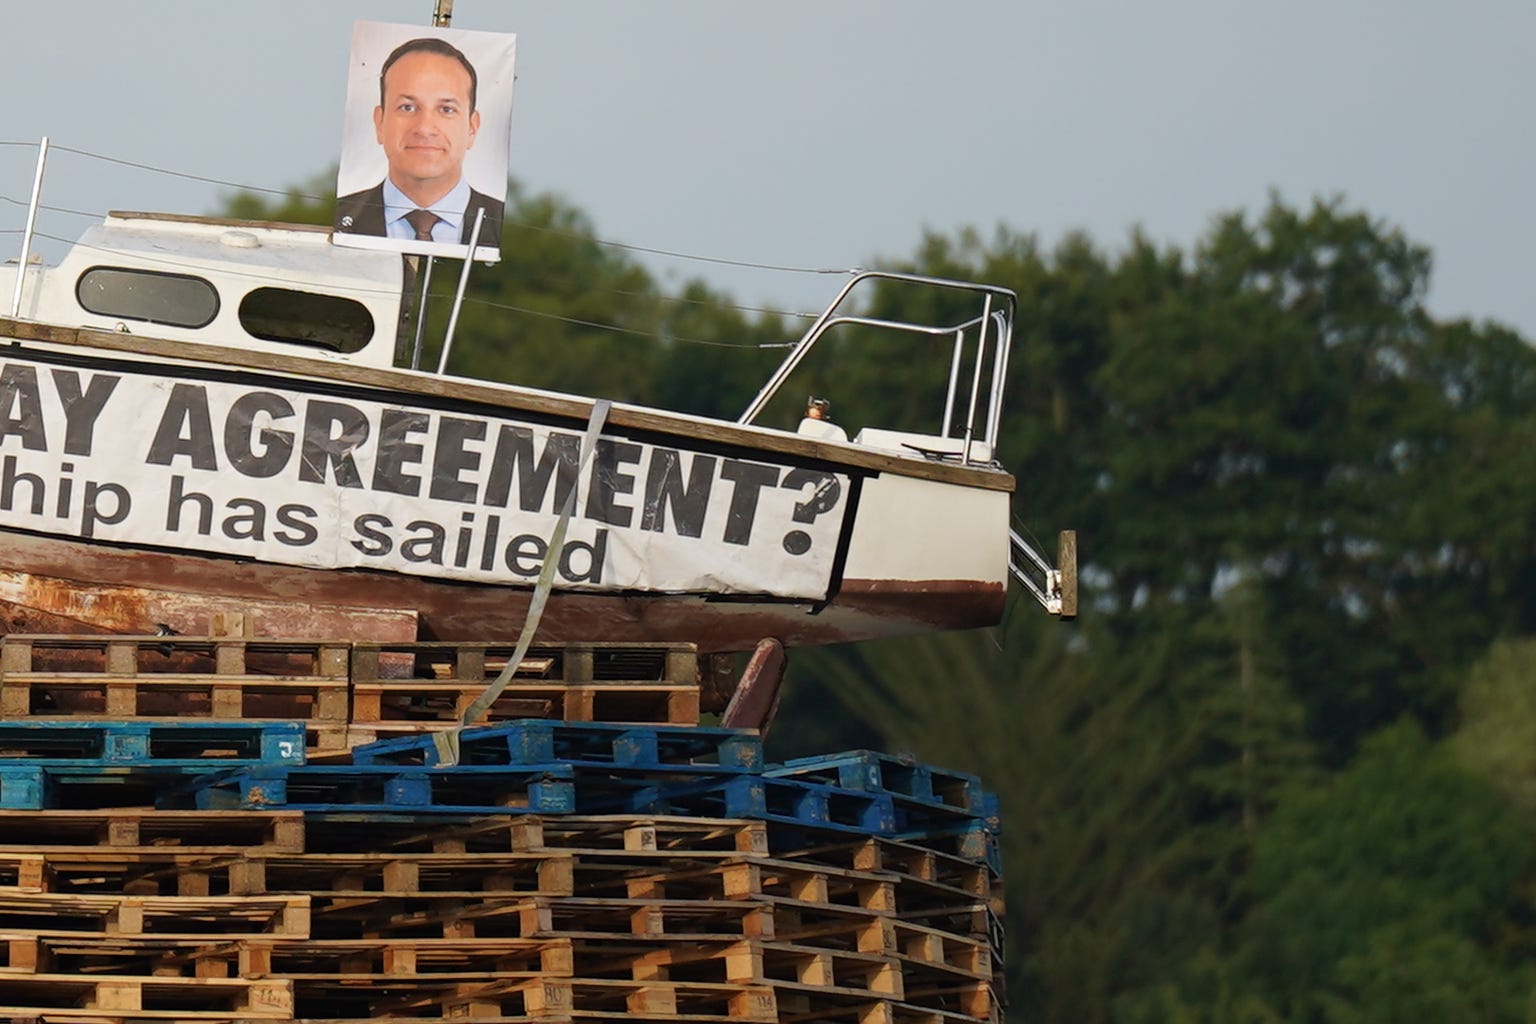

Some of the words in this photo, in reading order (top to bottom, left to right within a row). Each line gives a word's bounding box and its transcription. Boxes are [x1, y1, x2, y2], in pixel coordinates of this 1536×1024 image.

[146, 384, 841, 555] AGREEMENT?
[167, 475, 319, 547] has
[352, 512, 609, 584] sailed
